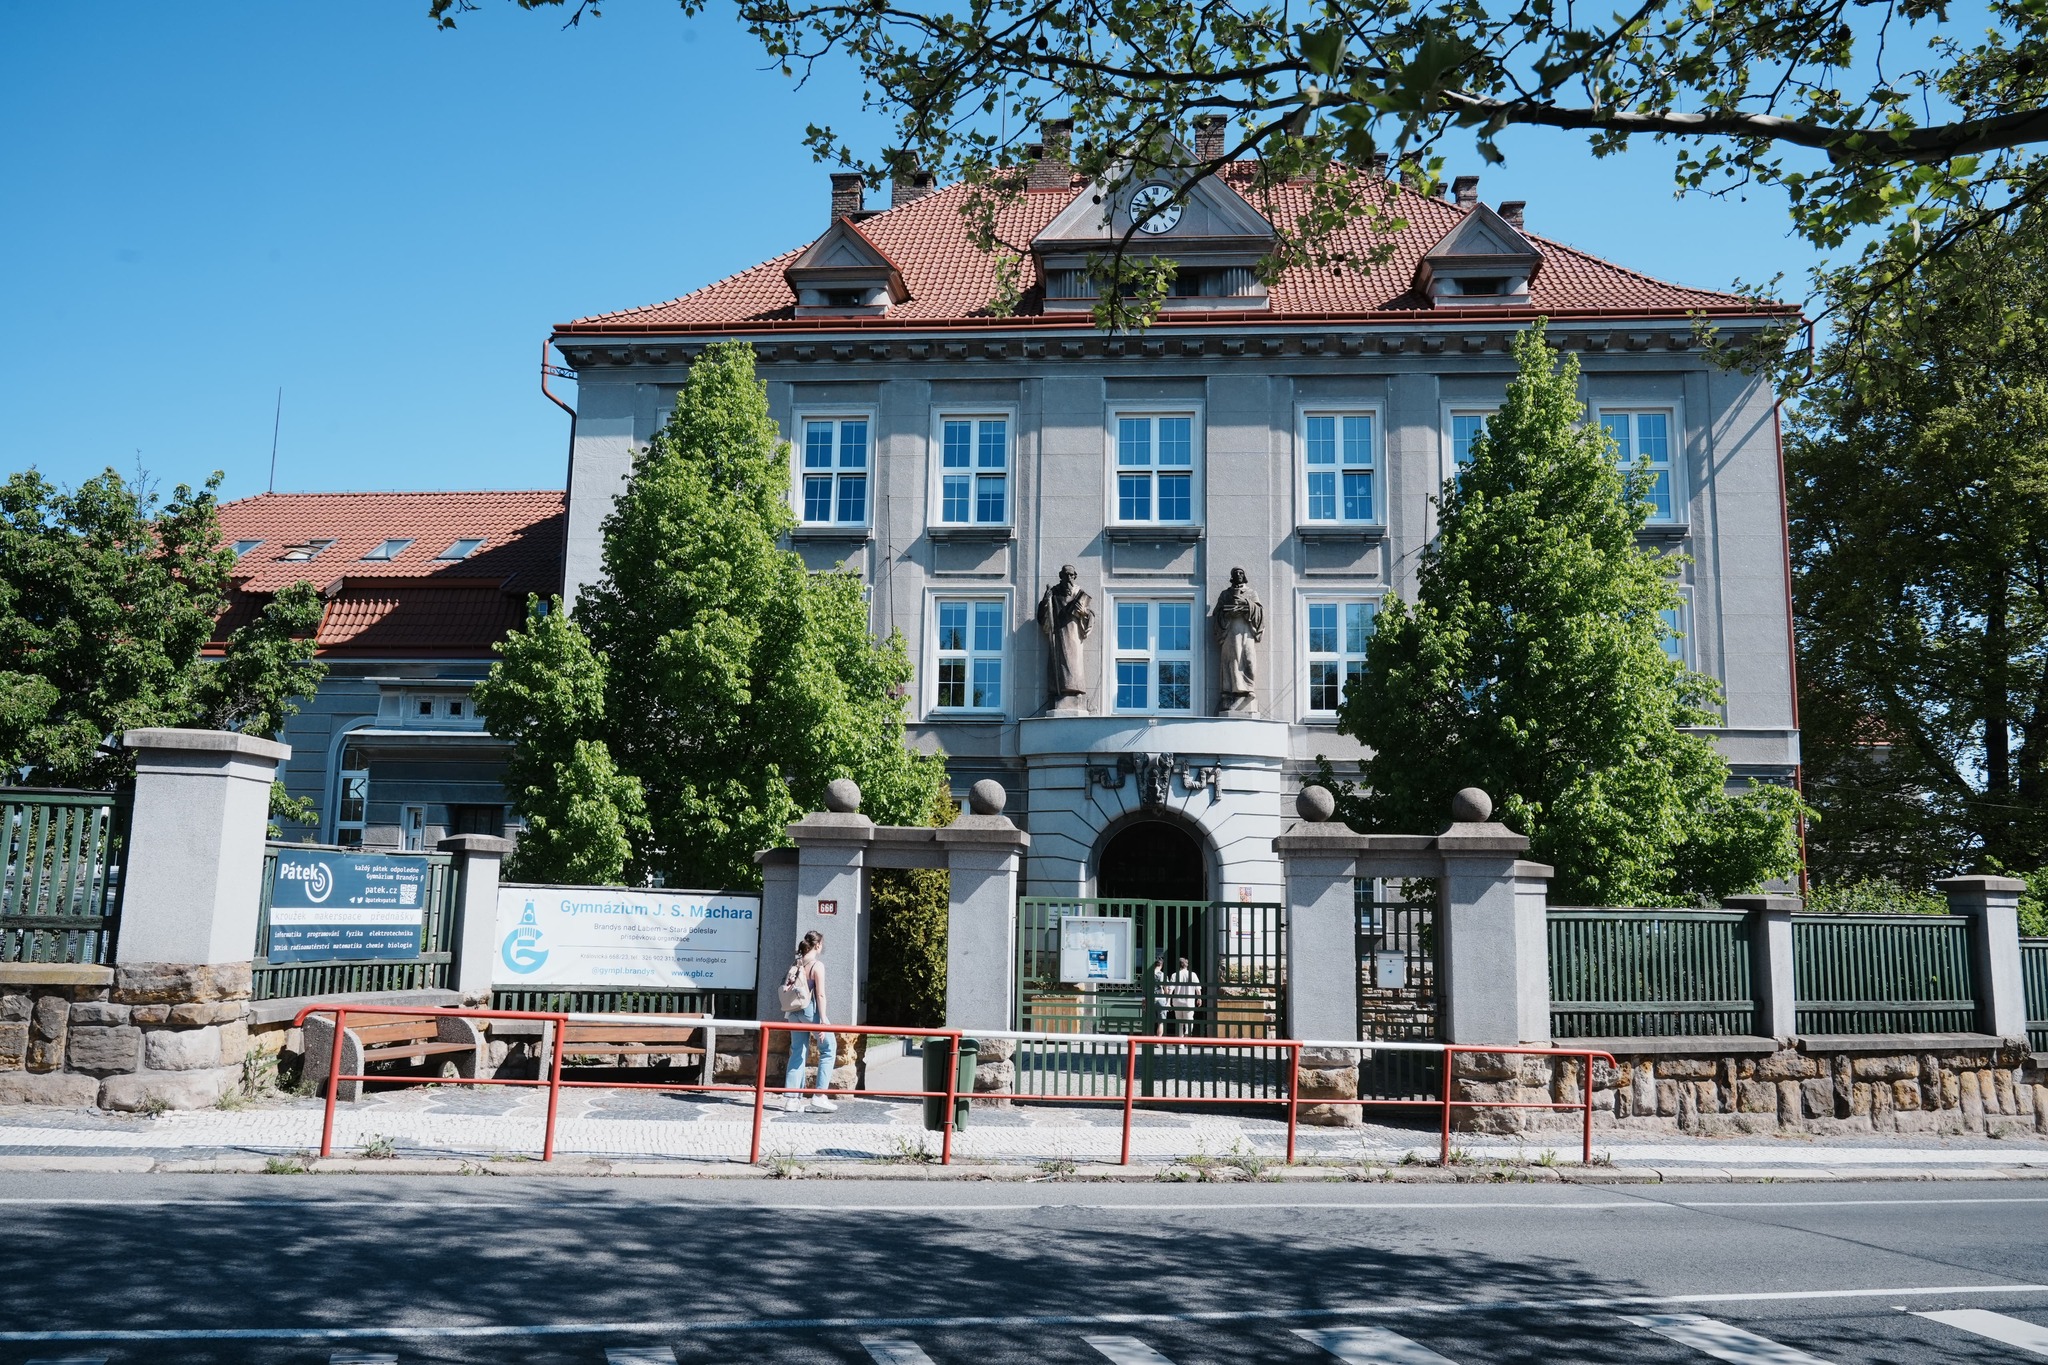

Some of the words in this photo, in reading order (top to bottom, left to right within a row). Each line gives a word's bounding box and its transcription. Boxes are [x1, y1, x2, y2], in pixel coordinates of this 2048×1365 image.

[280, 862, 318, 880] Pátek
[365, 886, 398, 895] patek.cz
[560, 900, 648, 916] Gymnázium
[652, 904, 665, 916] J.
[671, 904, 684, 917] S.
[690, 905, 752, 919] Machara
[820, 903, 834, 912] 668
[275, 910, 306, 920] kroužek
[314, 912, 362, 921] makerspace
[370, 911, 414, 921] přednášky
[594, 923, 621, 931] Brandýs
[592, 967, 655, 976] @gympl.brandys
[671, 970, 714, 978] www.gbl.cz
